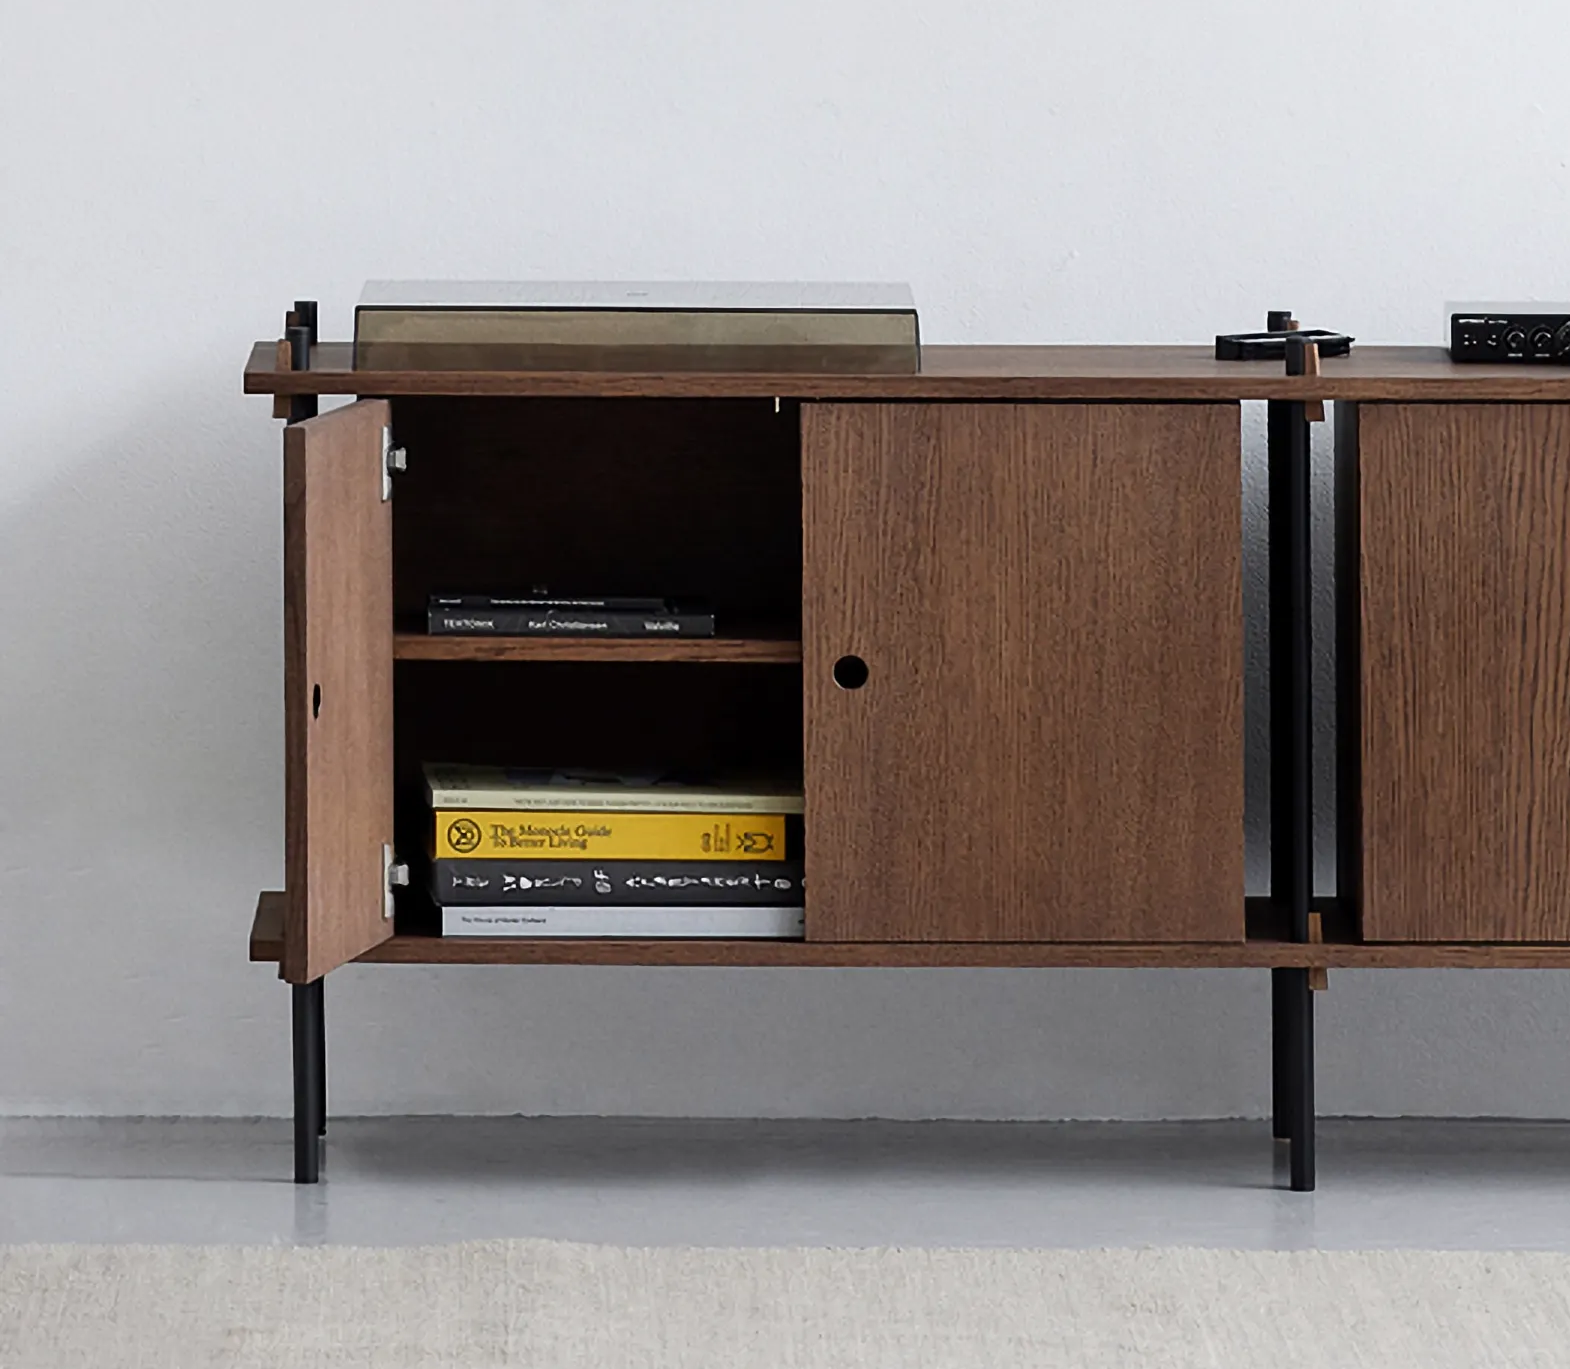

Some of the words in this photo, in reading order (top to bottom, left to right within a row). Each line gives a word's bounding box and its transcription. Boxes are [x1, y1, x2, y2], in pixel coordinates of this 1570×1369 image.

[490, 824, 515, 837] The
[574, 824, 612, 837] Guide
[549, 836, 588, 851] Living
